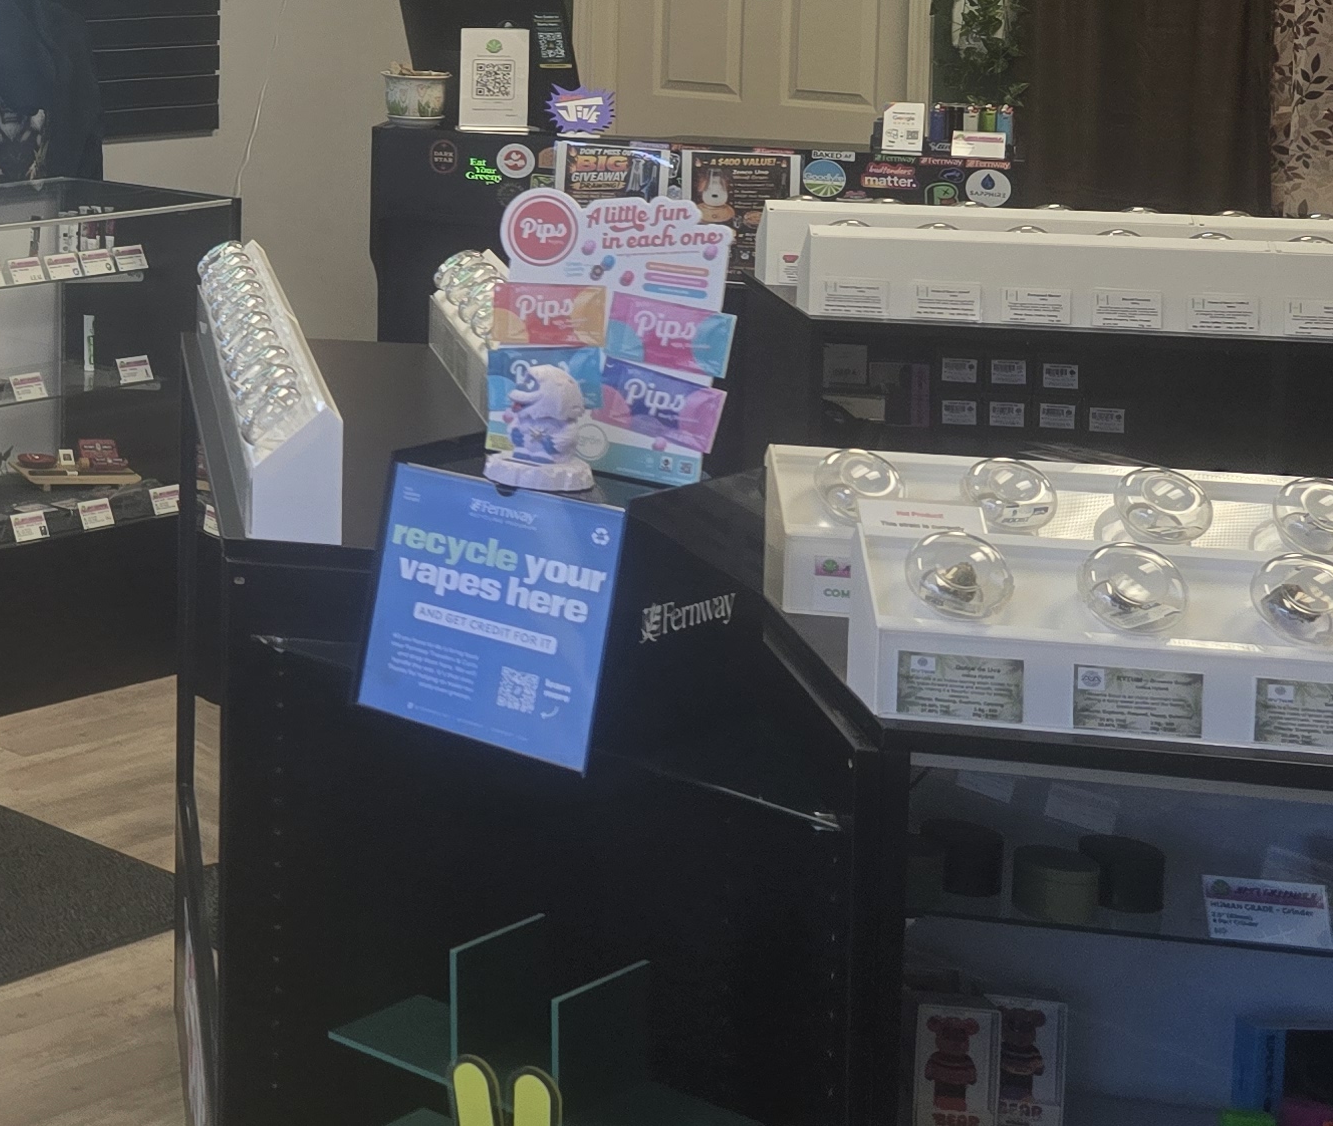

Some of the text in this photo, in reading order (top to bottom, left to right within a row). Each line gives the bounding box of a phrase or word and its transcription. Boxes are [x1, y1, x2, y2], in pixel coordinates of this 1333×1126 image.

[433, 150, 454, 158] DARK
[579, 147, 622, 157] DON'T MISS
[812, 150, 842, 160] BAKED
[469, 157, 487, 166] Eat
[576, 155, 629, 173] BIG
[718, 157, 741, 167] $400
[742, 157, 776, 167] VALUE!
[474, 166, 497, 175] Your
[571, 171, 628, 182] GIVEAWAY
[465, 172, 502, 184] Greens
[864, 176, 917, 188] matter.
[969, 190, 1007, 199] SAPPHIRE
[586, 204, 691, 228] A little fun
[520, 218, 567, 244] Pips
[602, 224, 724, 249] in each one
[515, 294, 575, 326] Pips
[634, 310, 696, 347] Pips
[624, 377, 685, 415] Pips
[391, 522, 607, 593] recycle your
[399, 556, 589, 624] vapes here
[823, 588, 851, 598] COM
[662, 592, 736, 635] Fernway
[418, 606, 552, 650] AND GET CREDIT FOR IT
[1210, 900, 1243, 910] HUMAN
[1244, 904, 1274, 914] GRADE
